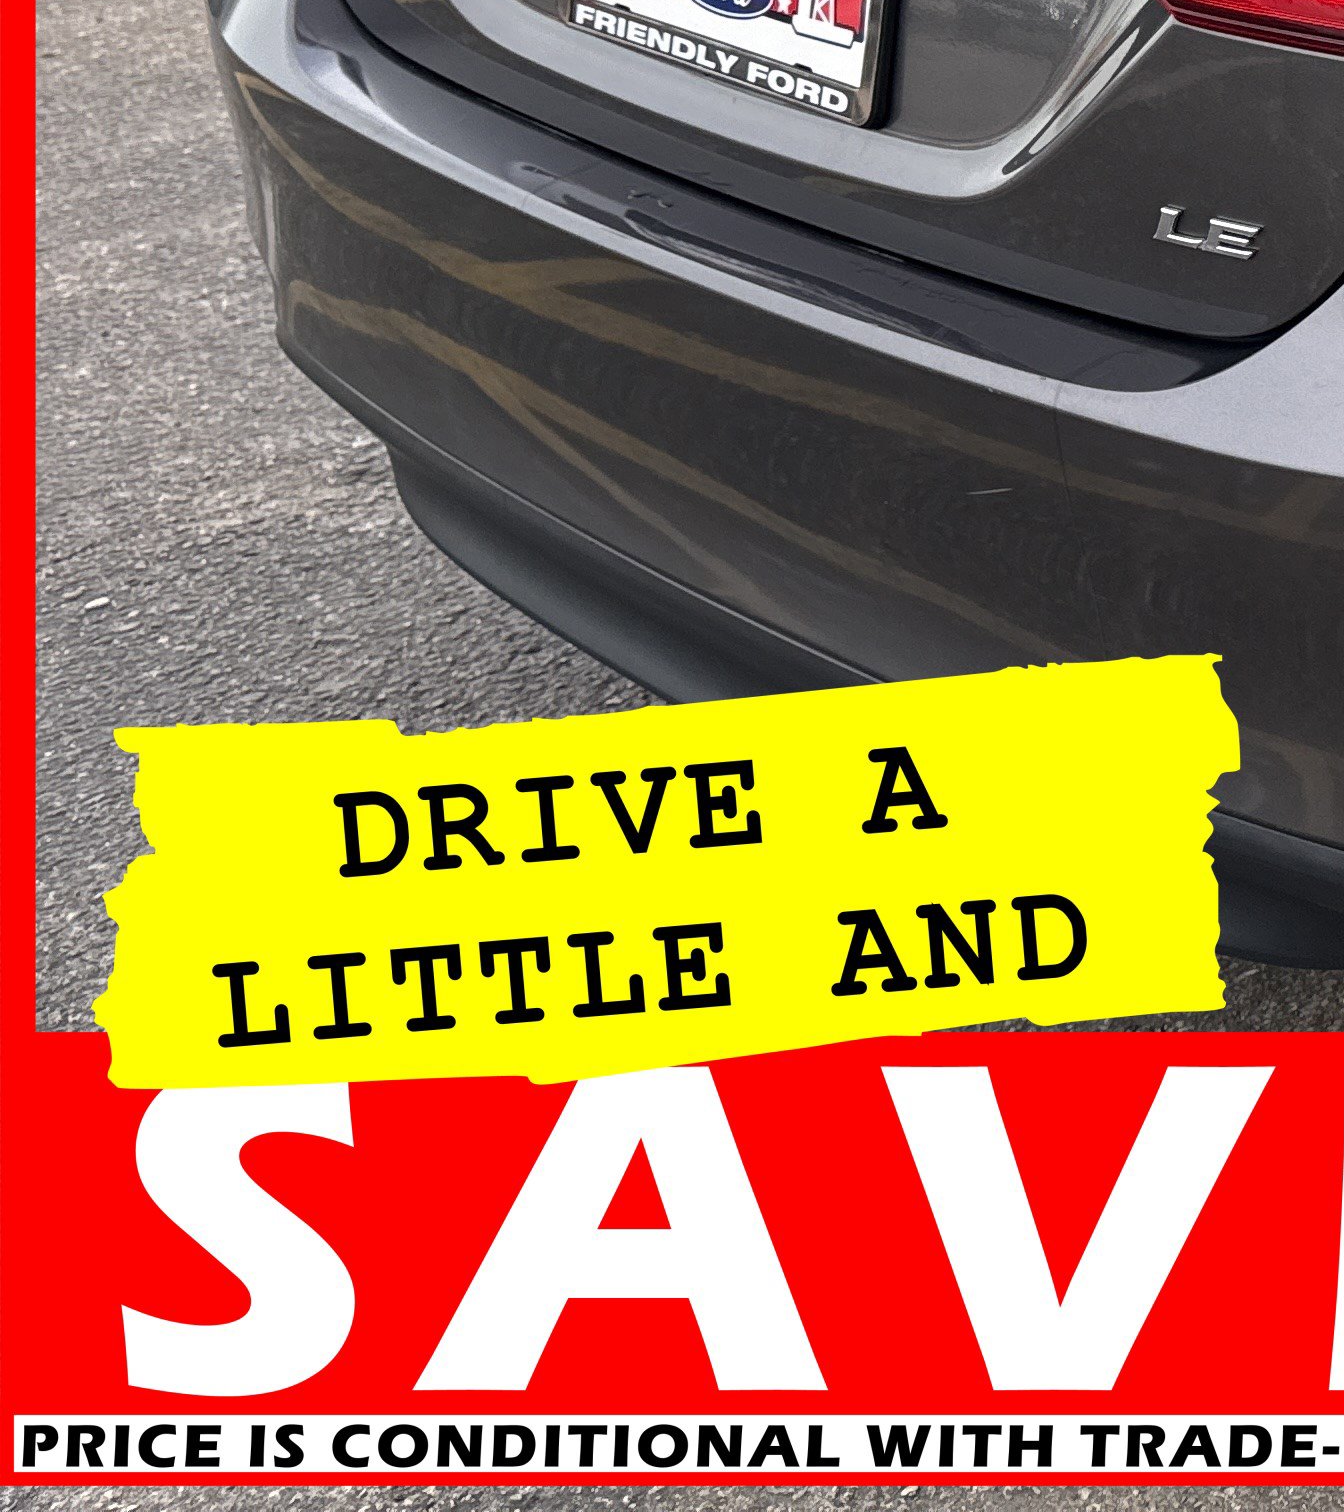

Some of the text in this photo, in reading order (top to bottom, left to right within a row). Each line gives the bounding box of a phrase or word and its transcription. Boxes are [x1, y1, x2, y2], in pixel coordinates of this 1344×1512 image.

[575, 3, 849, 113] FRIENDLY FORD
[1153, 205, 1263, 260] LE
